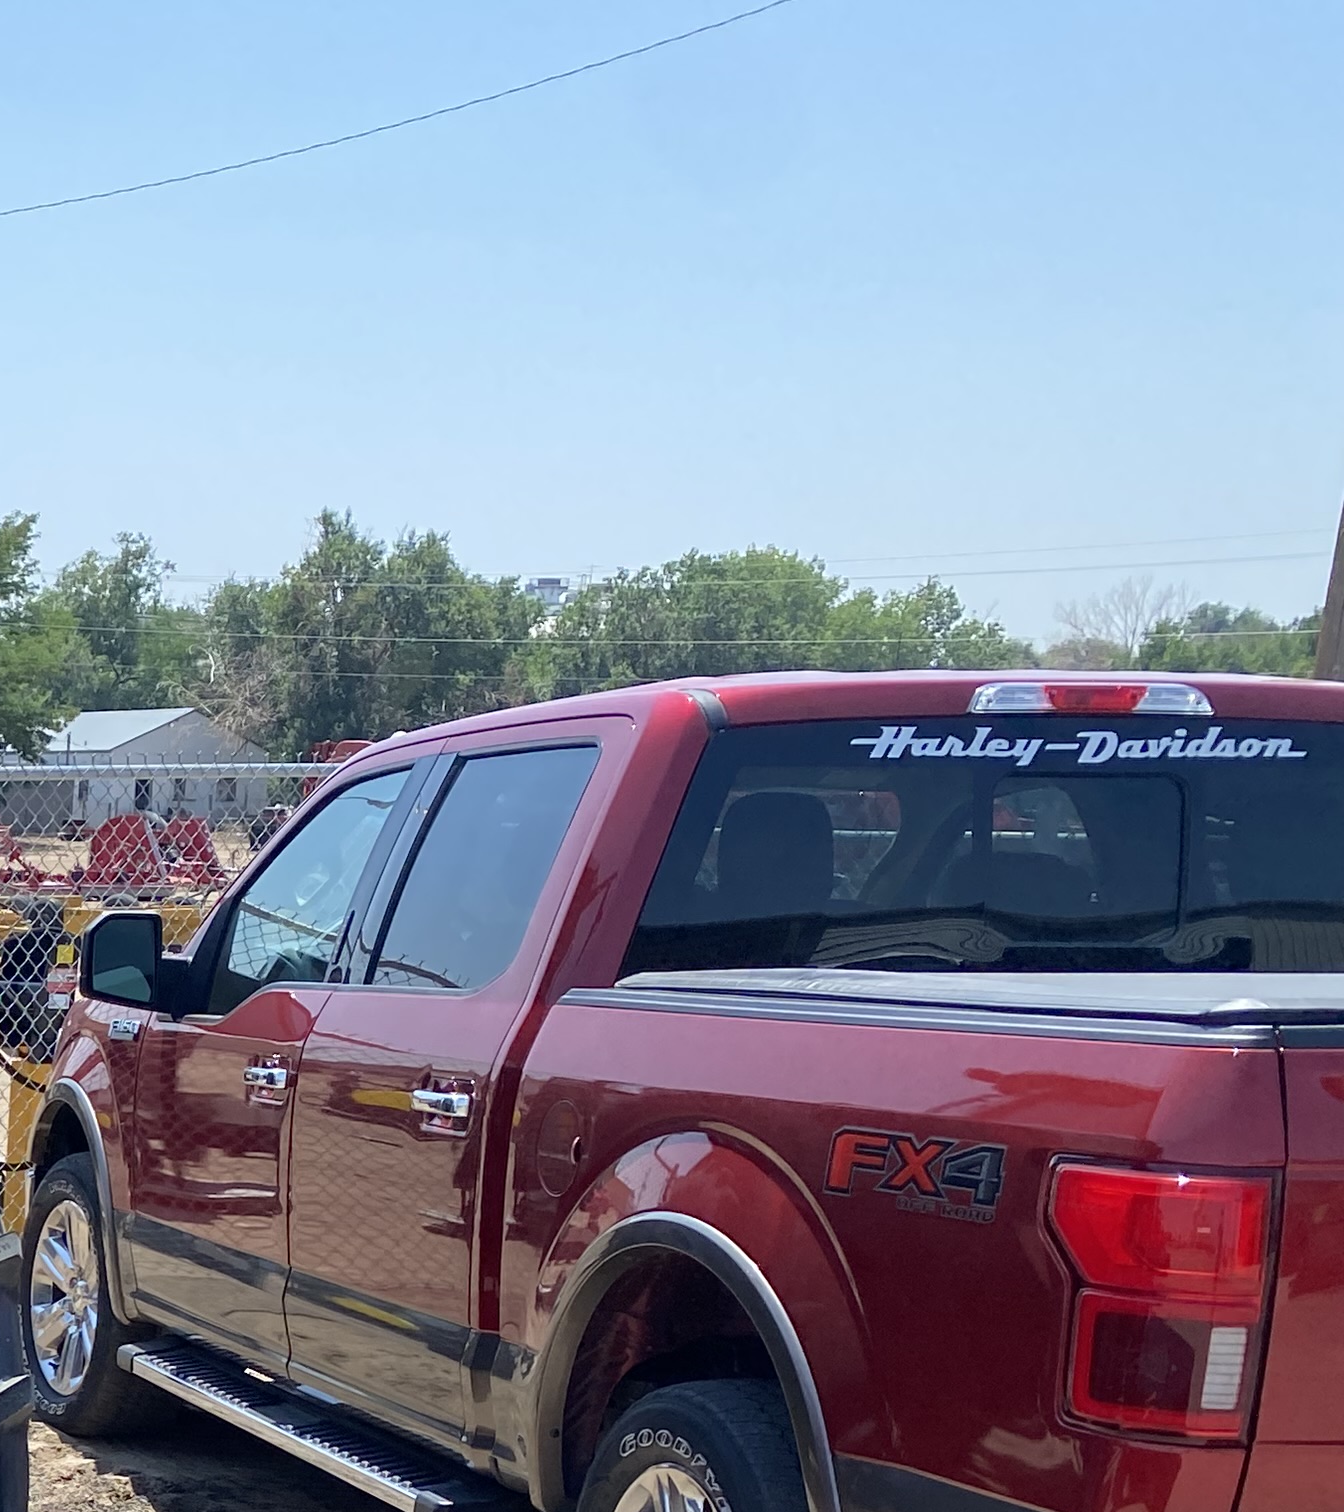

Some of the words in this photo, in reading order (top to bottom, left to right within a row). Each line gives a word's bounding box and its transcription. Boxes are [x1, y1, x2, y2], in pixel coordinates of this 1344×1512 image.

[850, 726, 1308, 767] Harley-Davidson
[822, 1125, 1008, 1209] FX4
[940, 1203, 995, 1224] ROAD
